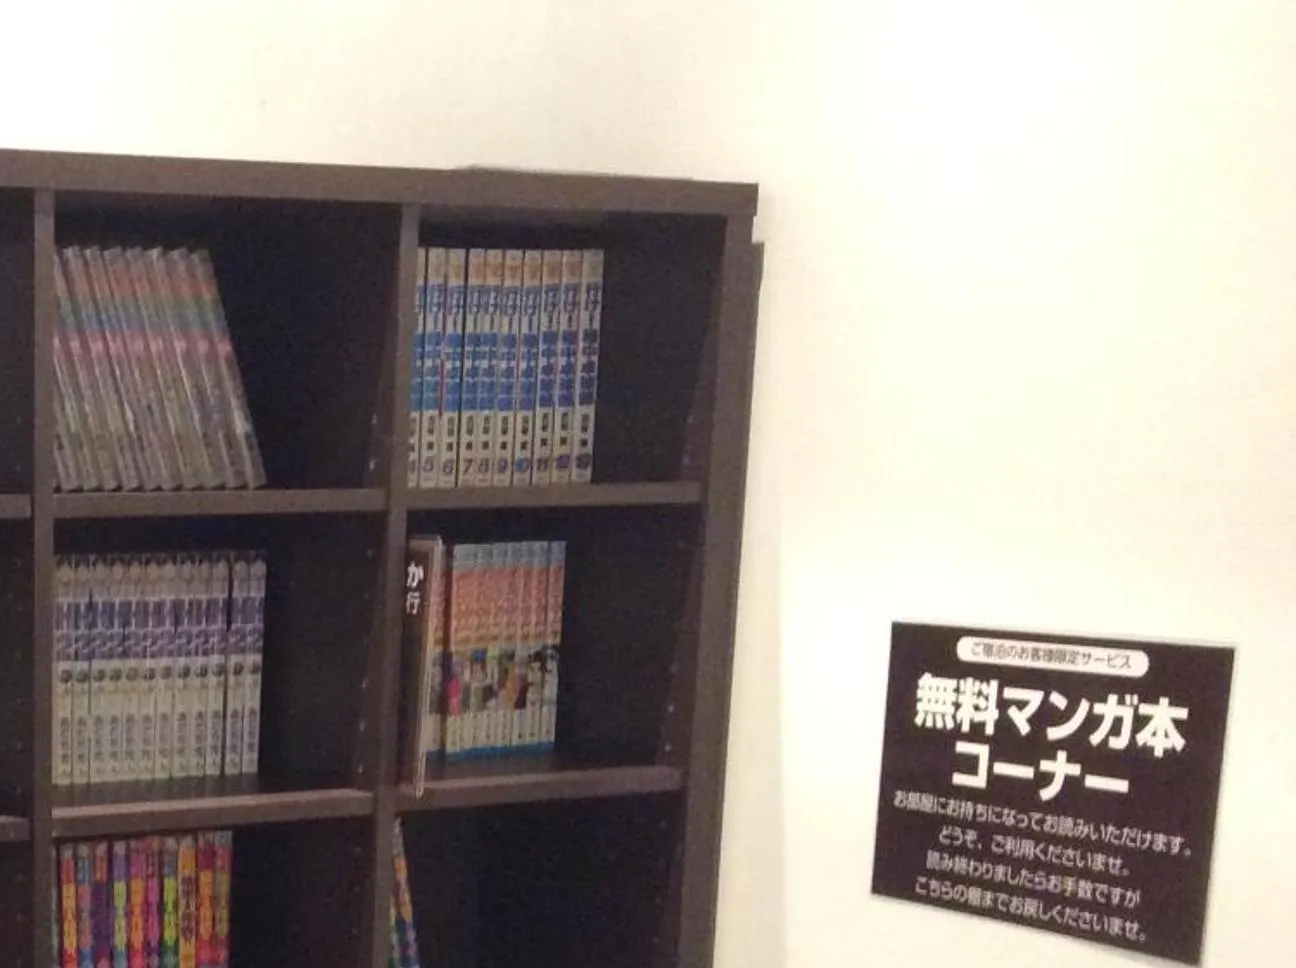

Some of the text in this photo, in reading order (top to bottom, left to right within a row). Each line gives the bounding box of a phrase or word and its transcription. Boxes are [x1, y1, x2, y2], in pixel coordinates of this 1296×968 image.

[406, 561, 425, 615] か行
[914, 672, 1189, 758] 無料マンガ本
[951, 741, 1130, 801] コーナー
